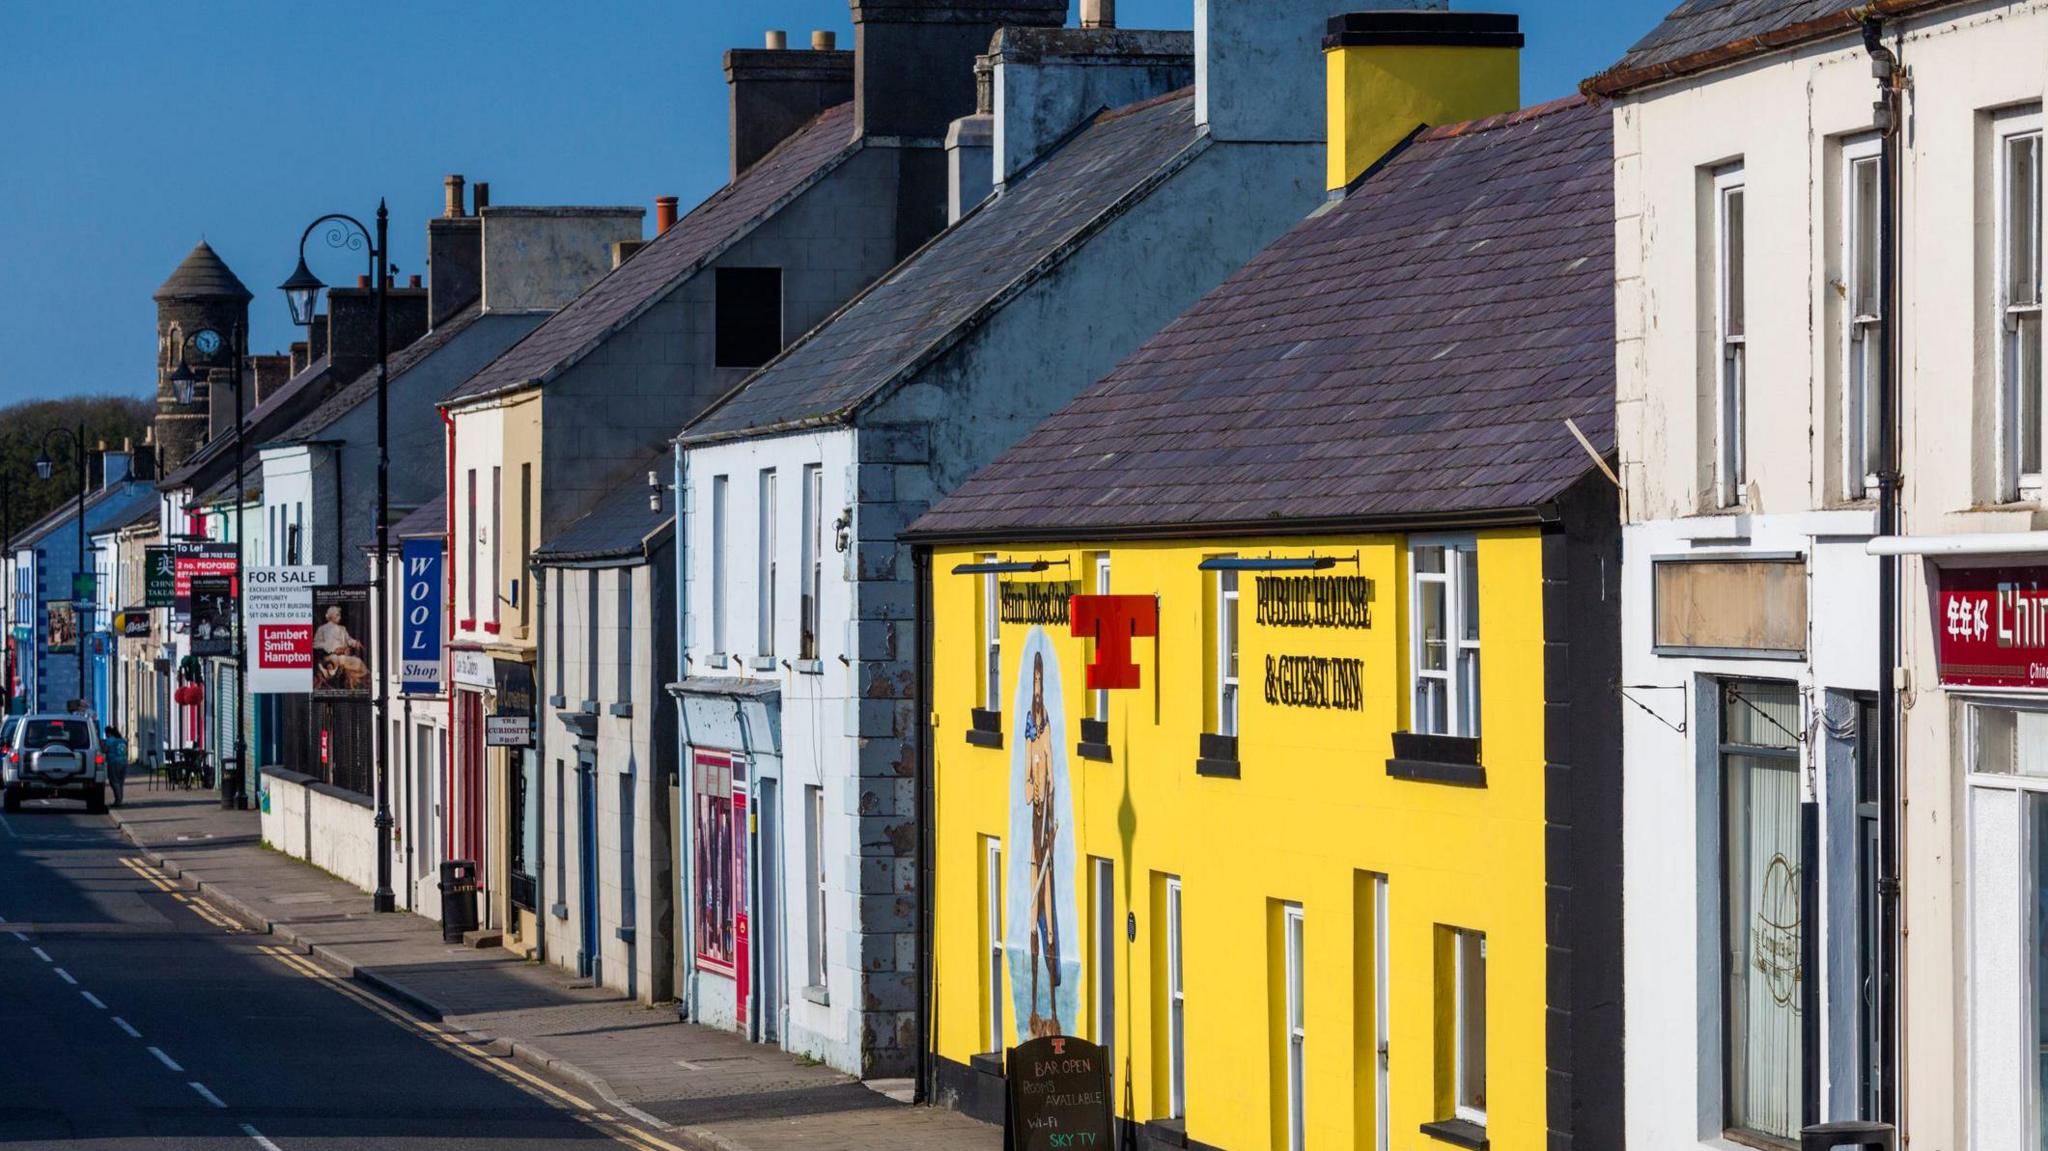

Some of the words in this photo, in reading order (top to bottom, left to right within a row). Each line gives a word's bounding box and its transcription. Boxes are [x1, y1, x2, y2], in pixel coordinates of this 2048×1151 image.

[177, 544, 188, 552] To
[190, 544, 204, 552] Let
[249, 571, 277, 583] FOR
[281, 571, 316, 583] SALE
[410, 557, 434, 650] WOOL
[1256, 576, 1312, 627] PUBLIC
[1313, 576, 1371, 629] HOUSE
[264, 629, 308, 640] Lambert
[1071, 594, 1156, 690] T
[264, 641, 295, 651] Smith
[264, 652, 311, 664] Hampton
[403, 664, 438, 679] Shop
[1264, 654, 1278, 705] &
[1278, 655, 1329, 709] GUEST
[1331, 657, 1364, 712] INN
[1051, 1038, 1066, 1055] T
[1034, 1062, 1058, 1078] BAR
[1062, 1059, 1091, 1074] OPEN
[1045, 1091, 1102, 1107] AVAILABLE
[1050, 1133, 1075, 1149] SKY
[1077, 1132, 1096, 1146] TV
